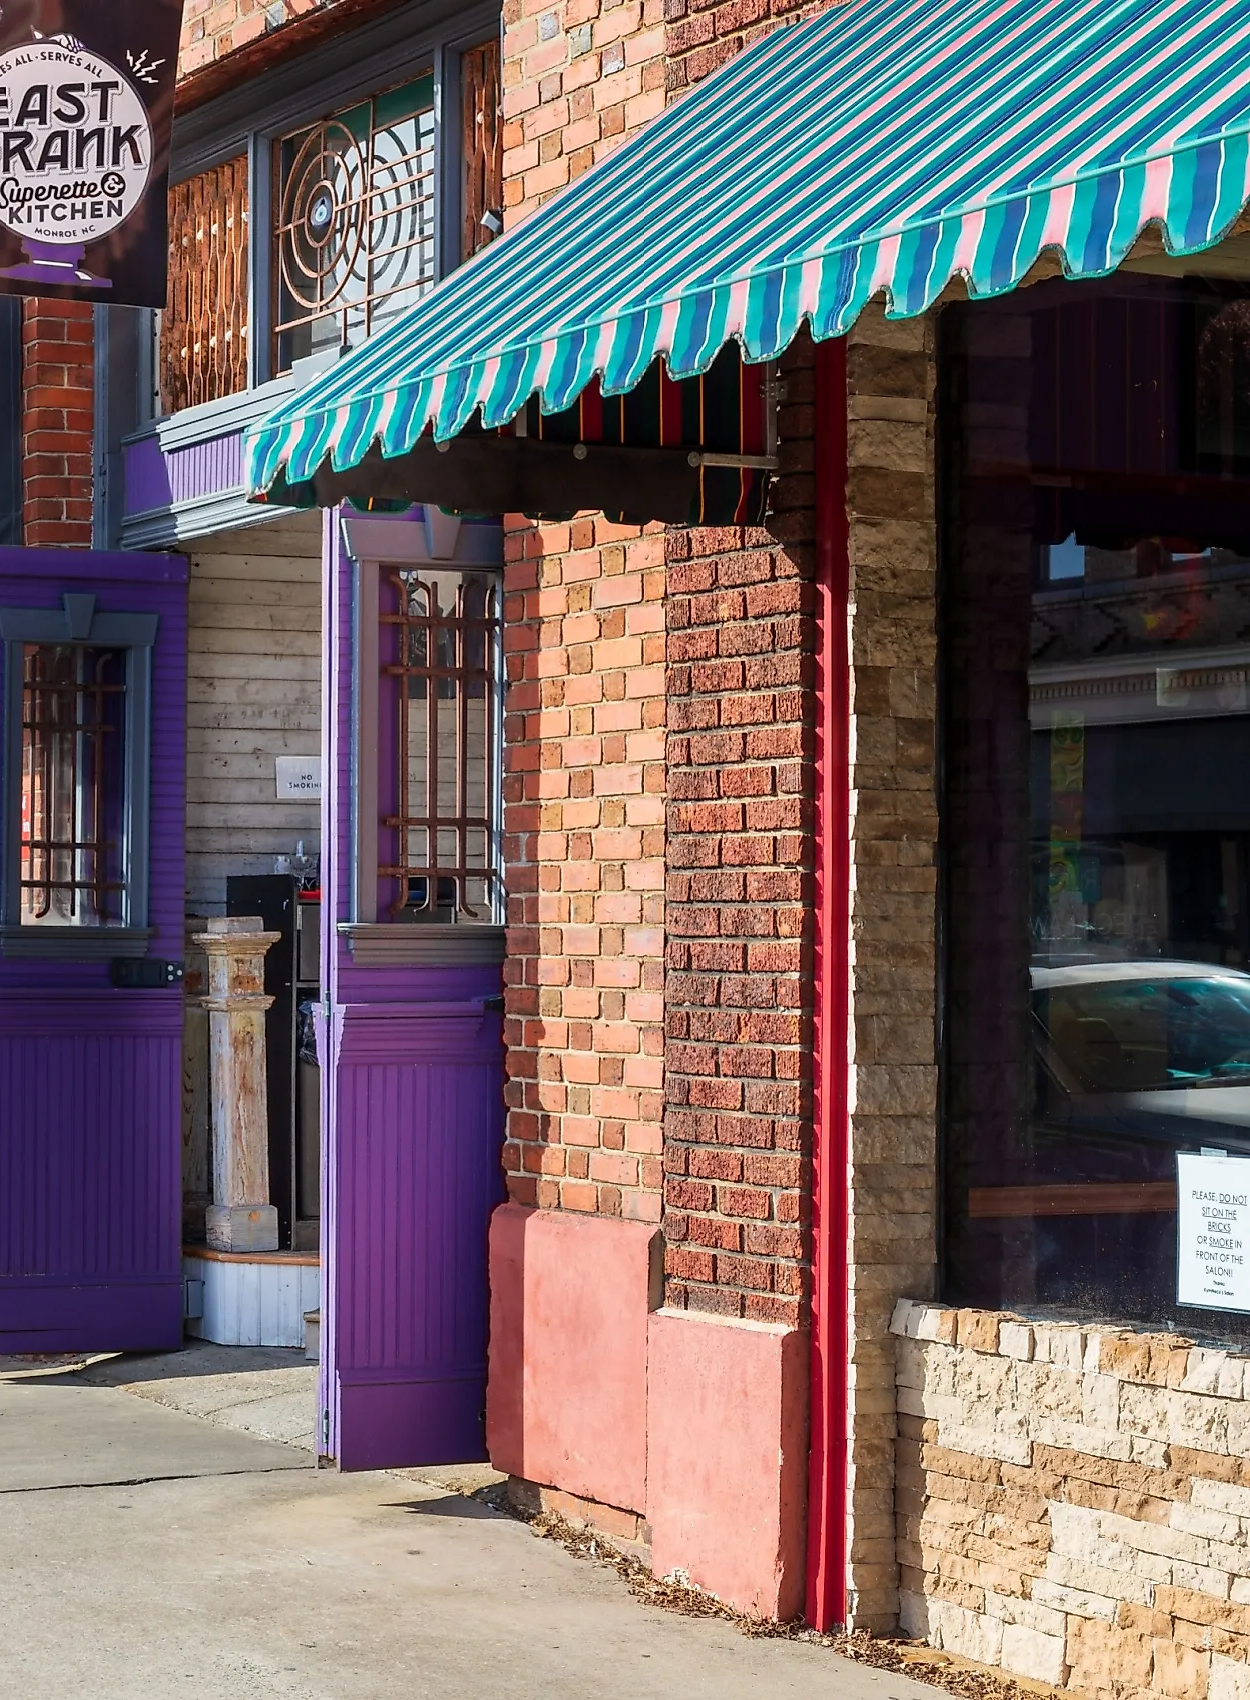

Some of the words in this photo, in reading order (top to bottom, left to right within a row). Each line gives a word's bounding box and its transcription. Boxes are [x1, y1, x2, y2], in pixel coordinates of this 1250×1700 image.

[15, 53, 34, 67] ALL
[40, 51, 83, 68] SERVES
[84, 62, 103, 78] ALL
[7, 200, 123, 225] KITCHEN
[34, 226, 78, 238] MONROE
[81, 224, 96, 235] NC
[288, 781, 322, 789] SMOKIN
[1219, 1193, 1231, 1203] DO
[1232, 1195, 1248, 1205] NOT
[1202, 1206, 1210, 1216] SIT
[1212, 1208, 1224, 1218] ON
[1225, 1209, 1237, 1219] THE
[1207, 1221, 1231, 1233] BRICKS
[1197, 1235, 1207, 1245] OR
[1209, 1237, 1233, 1248] SMOKE
[1235, 1240, 1242, 1248] IN
[1196, 1250, 1218, 1261] FRONT
[1219, 1253, 1230, 1263] OF
[1231, 1254, 1243, 1265] THE
